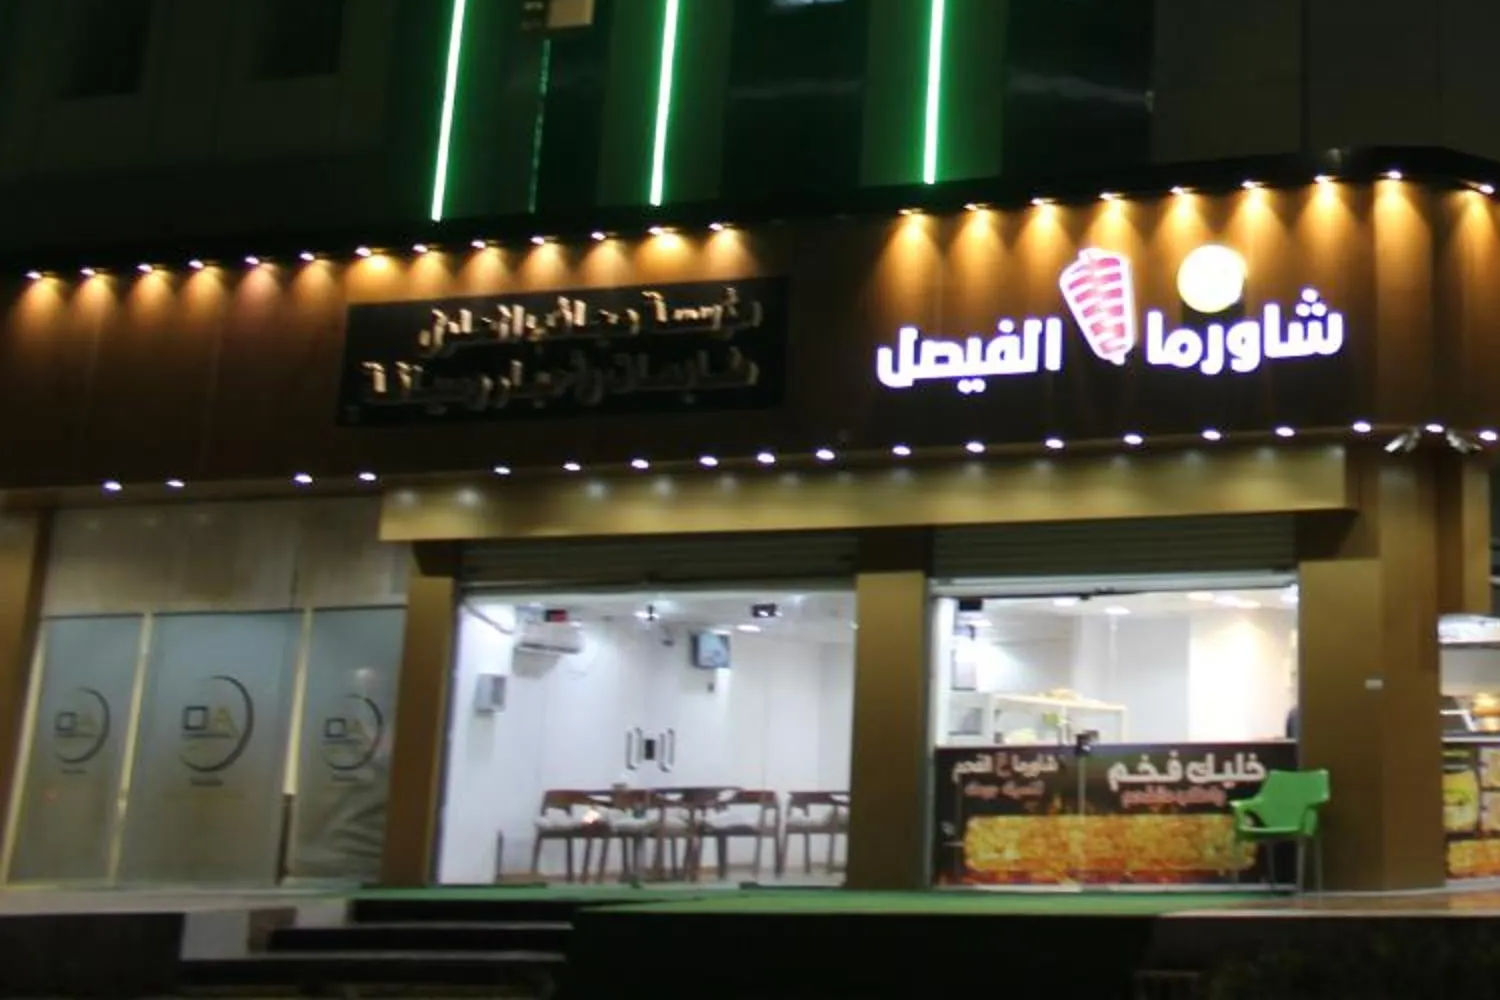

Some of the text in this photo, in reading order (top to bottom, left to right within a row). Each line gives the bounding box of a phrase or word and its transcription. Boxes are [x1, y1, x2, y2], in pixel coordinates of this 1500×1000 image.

[878, 288, 1342, 393] شاورما الفيصل
[1107, 751, 1267, 792] خليك فخم
